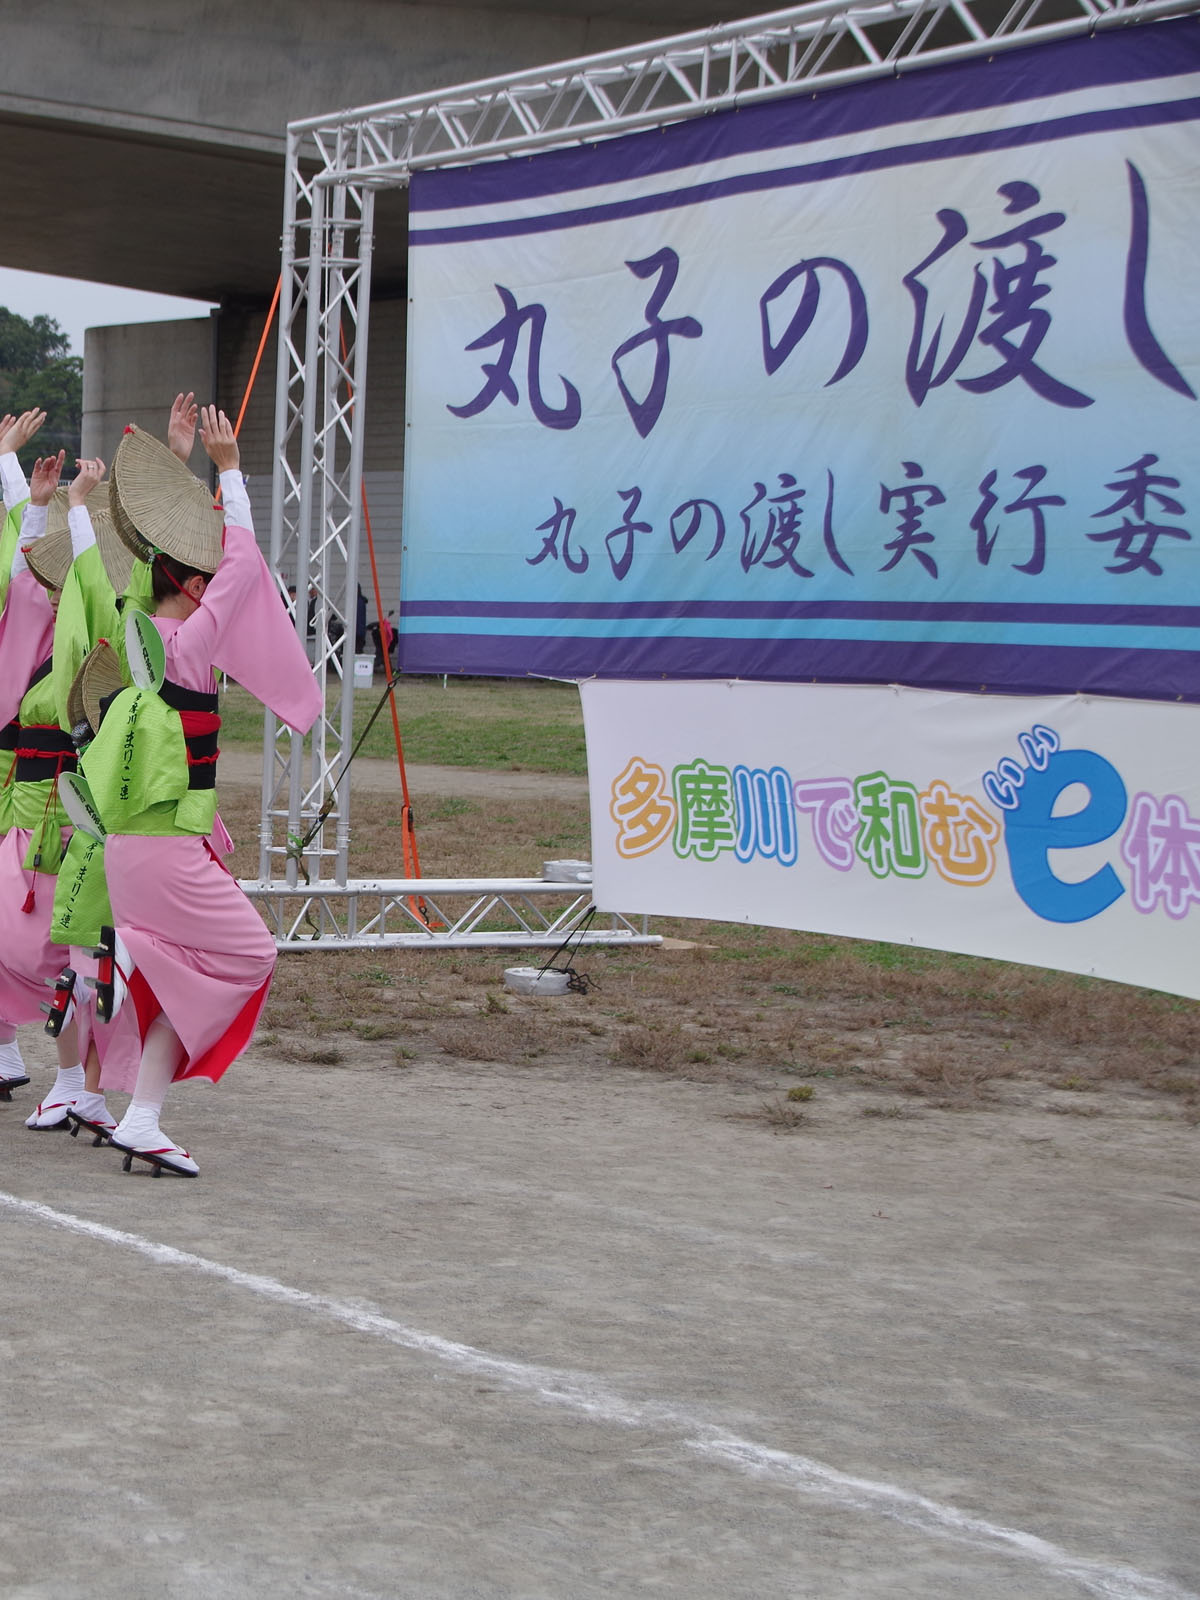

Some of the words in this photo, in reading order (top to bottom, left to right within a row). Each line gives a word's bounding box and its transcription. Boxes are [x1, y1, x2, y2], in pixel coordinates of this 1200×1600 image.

[446, 157, 1198, 439] 丸子の渡し
[525, 453, 1194, 581] 丸子の渡し実行委
[119, 730, 135, 800] まりこ連
